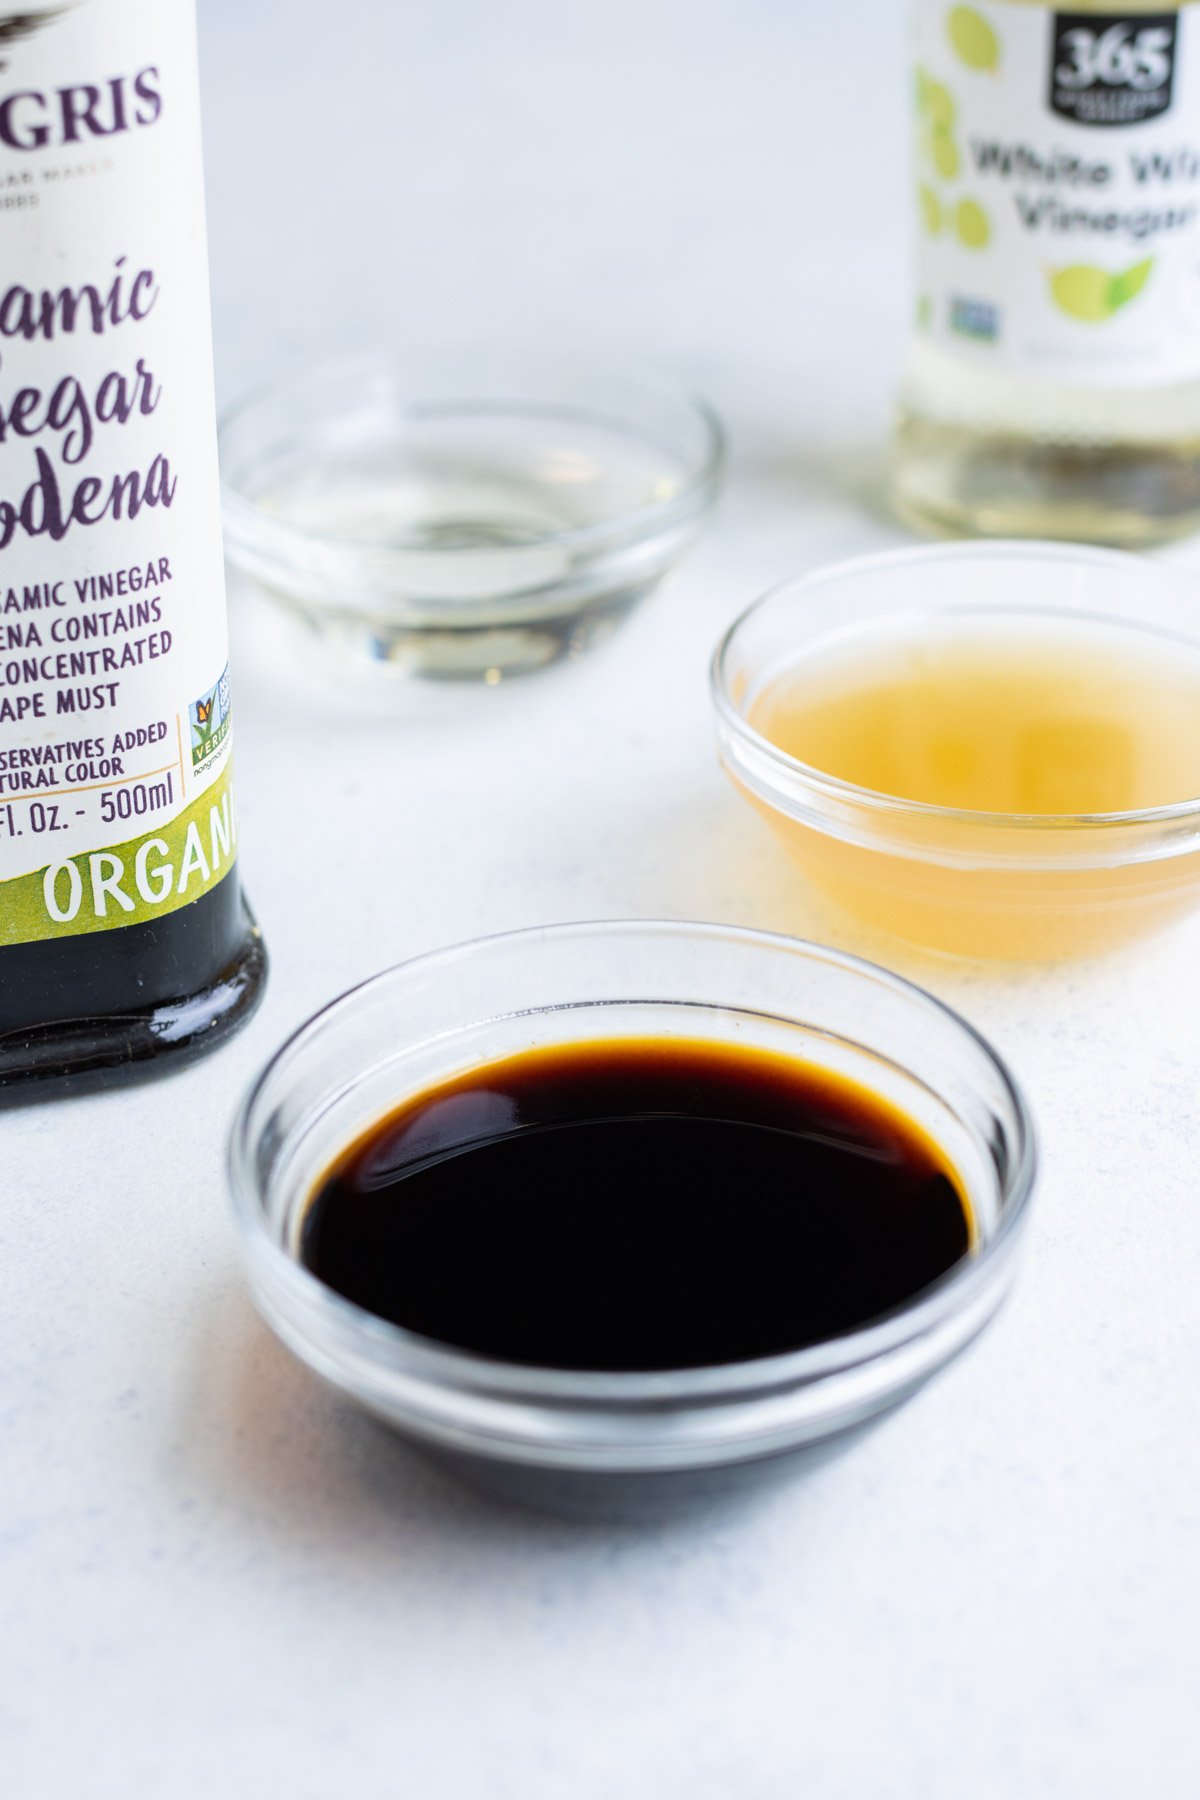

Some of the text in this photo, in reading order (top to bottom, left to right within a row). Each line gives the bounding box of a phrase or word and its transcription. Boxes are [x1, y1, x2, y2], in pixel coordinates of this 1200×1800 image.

[1056, 22, 1172, 91] 365
[969, 139, 1112, 185] White
[1014, 194, 1194, 240] Vinegar
[0, 256, 160, 341] amic
[0, 356, 162, 464] egar
[0, 557, 172, 615] AMIC VINEGAR
[51, 597, 162, 643] CONTAINS
[0, 682, 120, 722] APE MUST
[0, 721, 168, 771] SERVATIVES ADDED
[65, 757, 124, 783] COLOR
[30, 803, 69, 833] Oz.
[101, 772, 173, 823] 500ml
[43, 781, 236, 923] ORGANI
